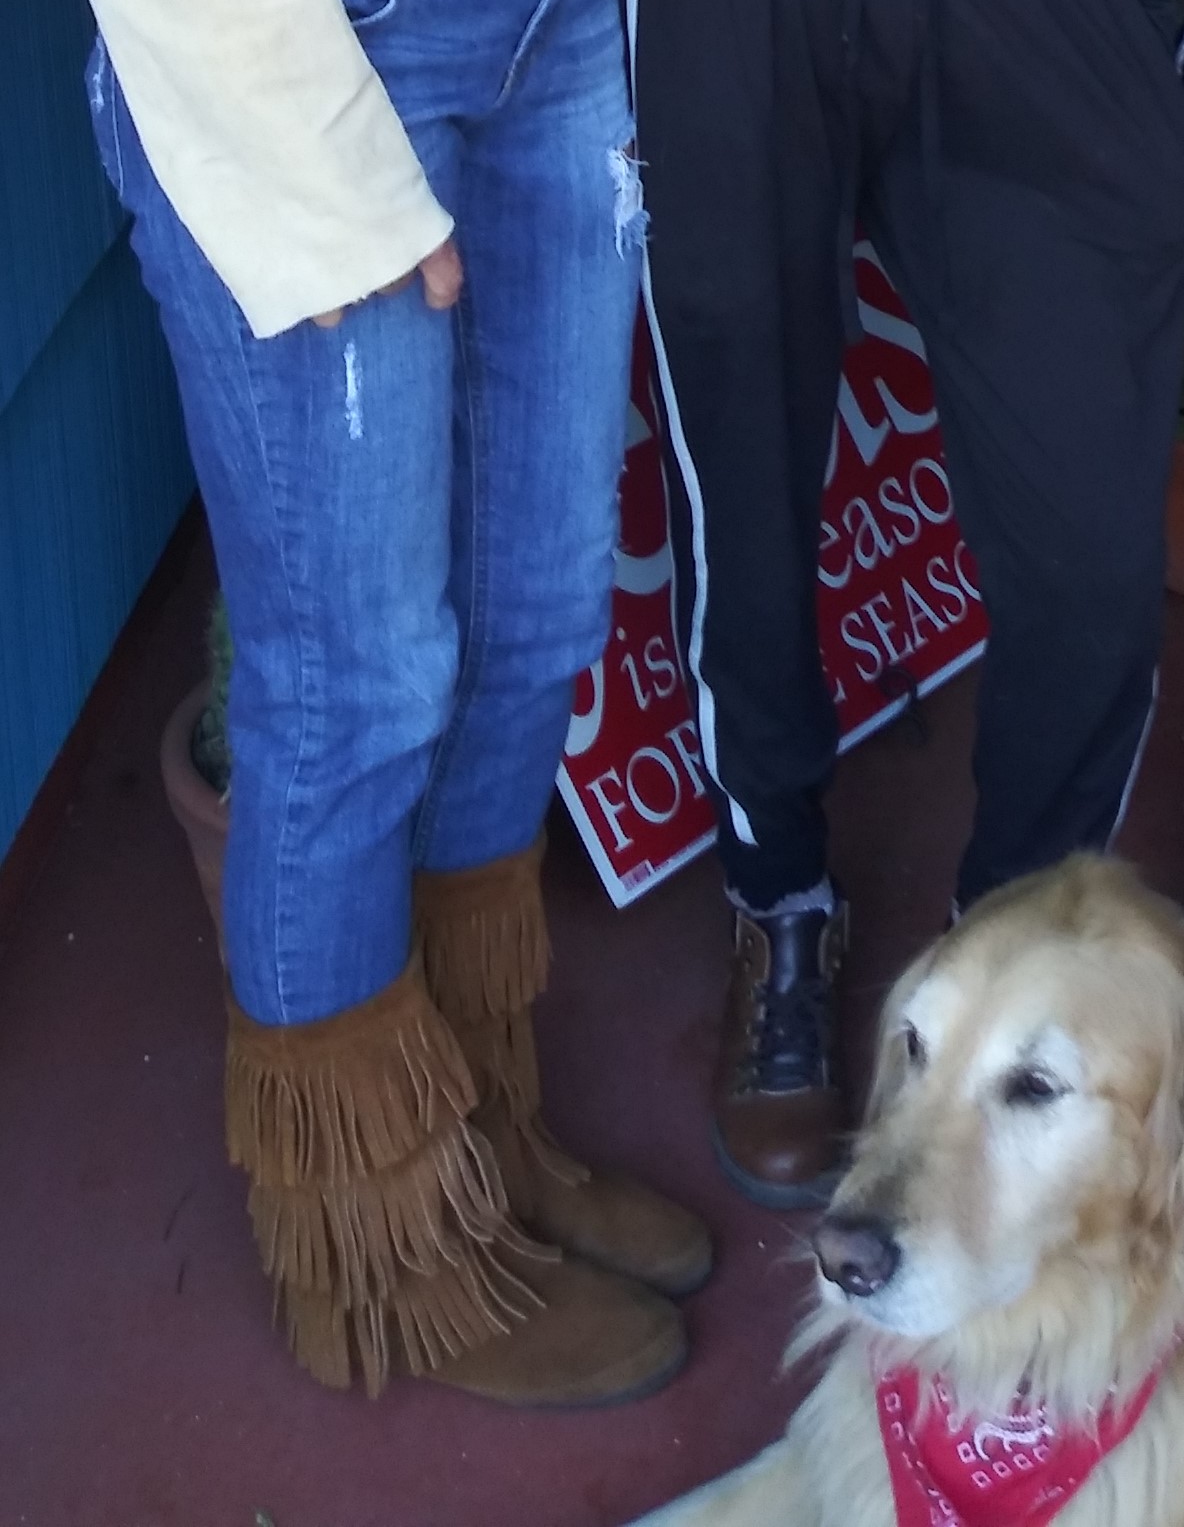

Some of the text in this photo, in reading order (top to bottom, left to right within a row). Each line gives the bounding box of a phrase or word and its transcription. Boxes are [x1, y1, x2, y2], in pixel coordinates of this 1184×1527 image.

[616, 626, 677, 711] is
[817, 457, 955, 589] easo
[840, 540, 983, 682] SEAS
